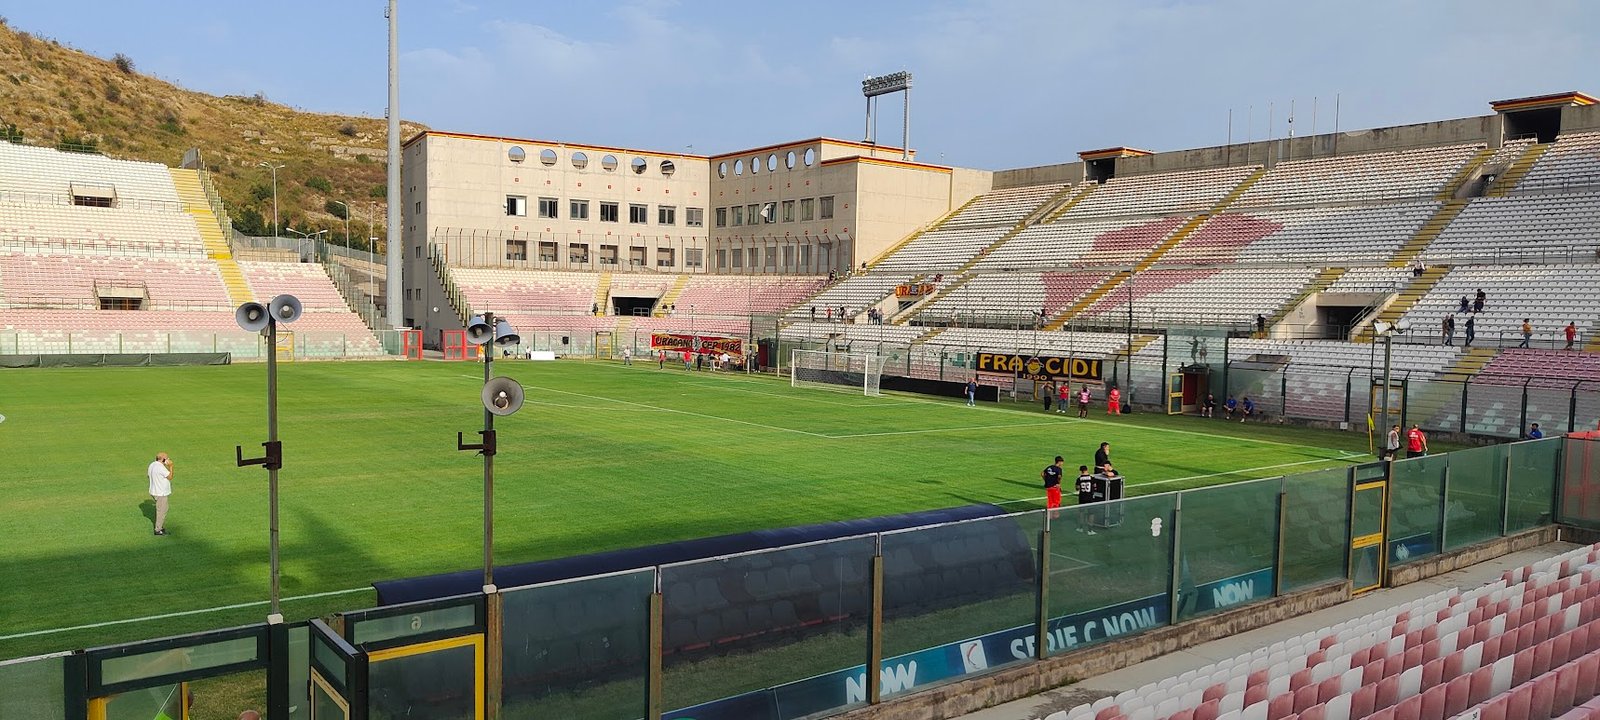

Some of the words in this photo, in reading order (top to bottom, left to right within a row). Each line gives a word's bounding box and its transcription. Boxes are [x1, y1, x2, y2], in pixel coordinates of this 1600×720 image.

[721, 341, 741, 352] 1982
[980, 354, 1024, 371] FRA
[1045, 358, 1098, 377] CIDI
[1080, 481, 1092, 493] 93
[1212, 579, 1254, 608] NOW
[1102, 606, 1157, 637] NOW
